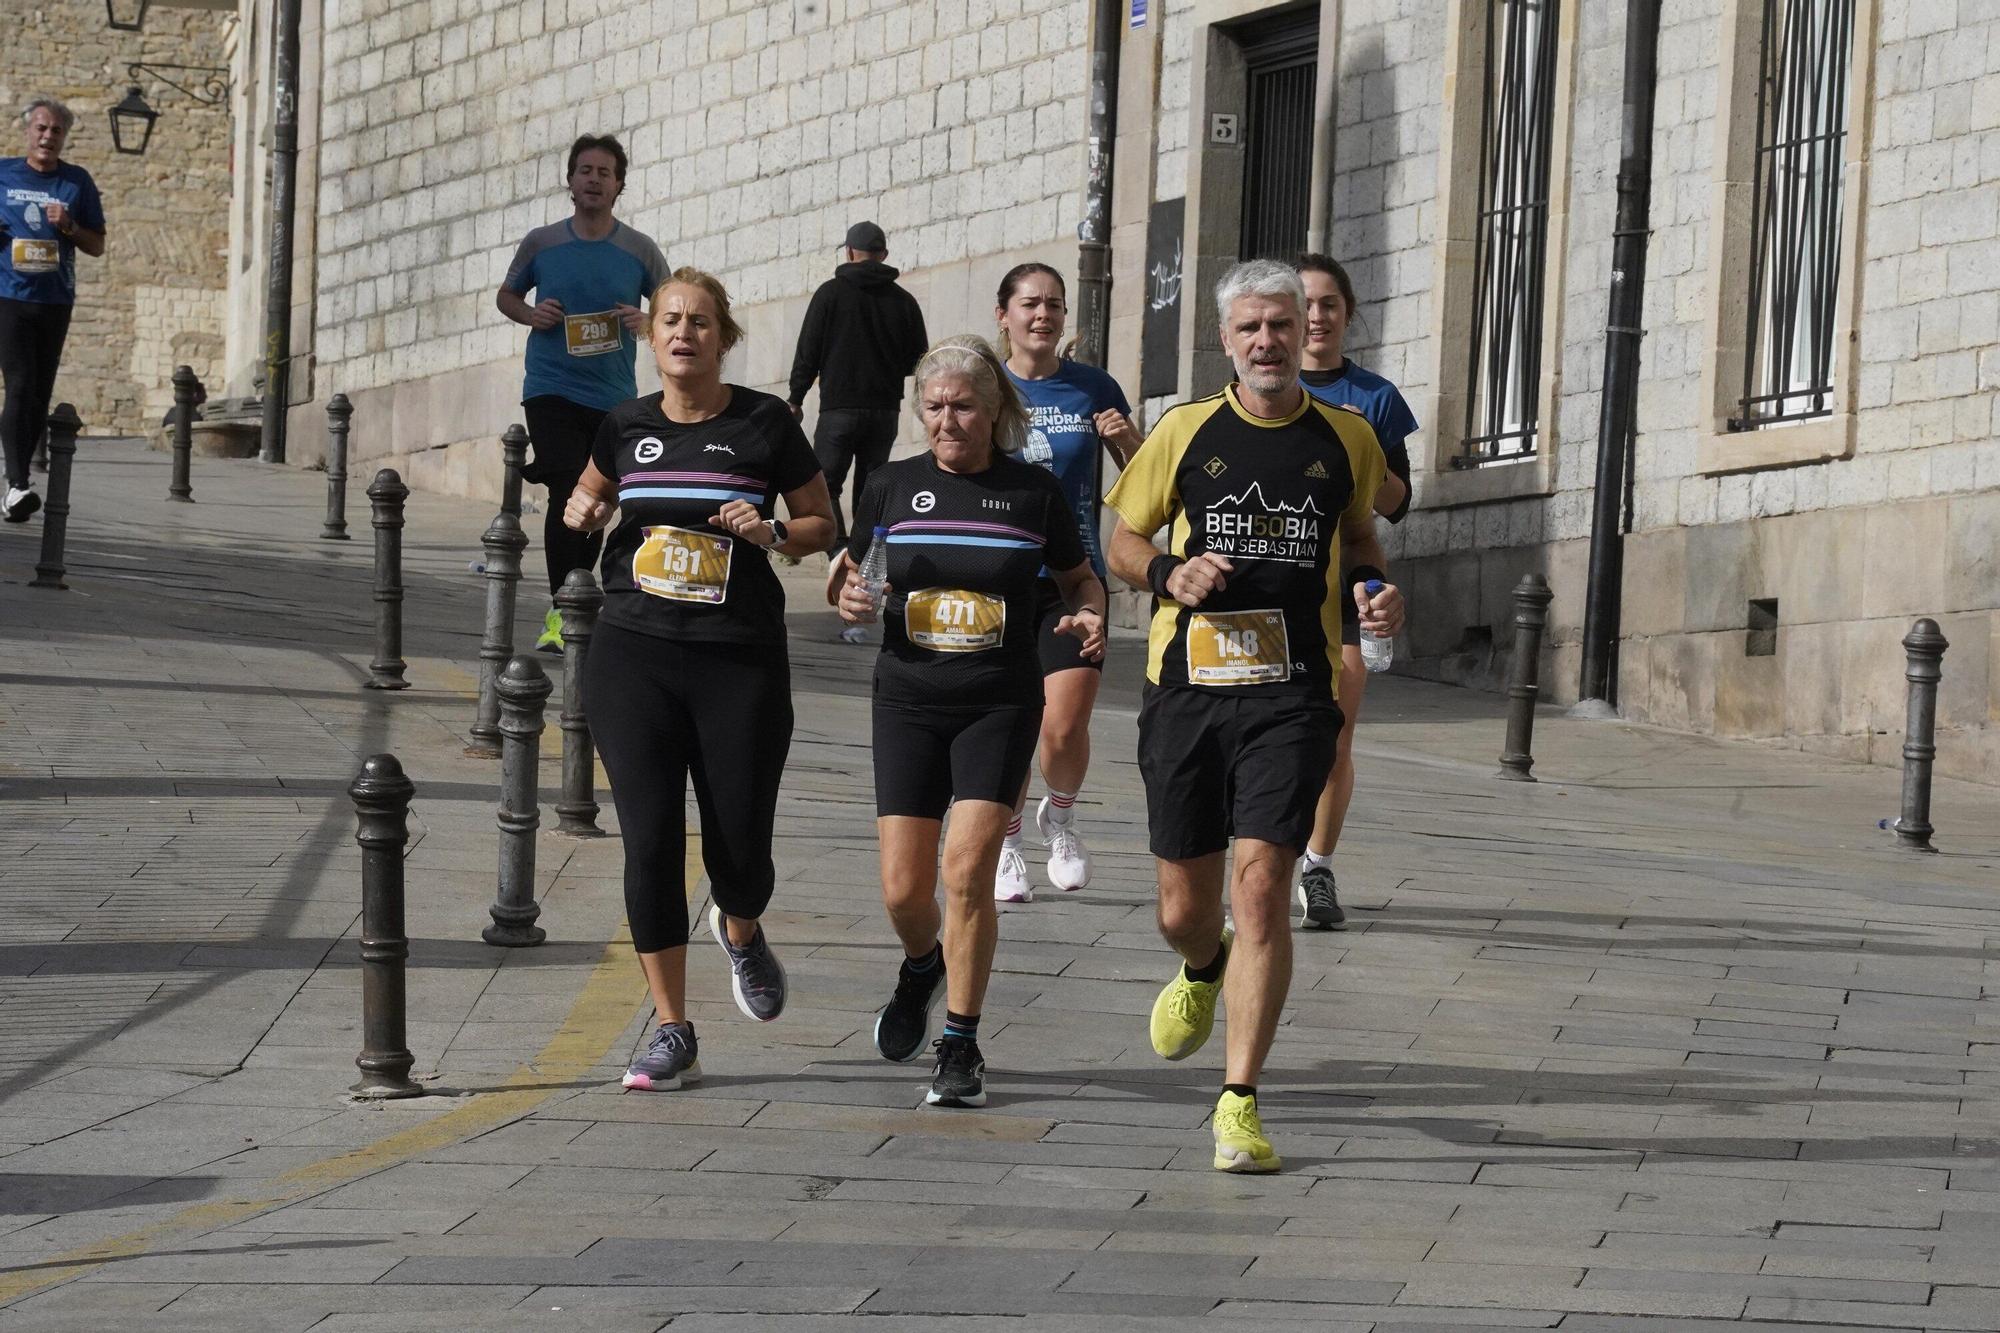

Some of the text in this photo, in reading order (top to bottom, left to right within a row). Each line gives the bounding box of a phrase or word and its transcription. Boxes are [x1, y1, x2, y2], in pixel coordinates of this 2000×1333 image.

[1217, 118, 1232, 138] 5
[581, 322, 608, 339] 298
[1047, 425, 1093, 434] KONKISTA
[703, 443, 735, 455] Spiuk
[982, 499, 1011, 511] GOBIK
[1206, 512, 1319, 540] BEH50BIA
[1206, 535, 1317, 557] SAN SEBASTIAN
[662, 545, 701, 575] 131
[669, 573, 687, 582] ELENA
[936, 600, 975, 625] 471
[1266, 616, 1279, 624] 10K
[1214, 629, 1259, 657] 148
